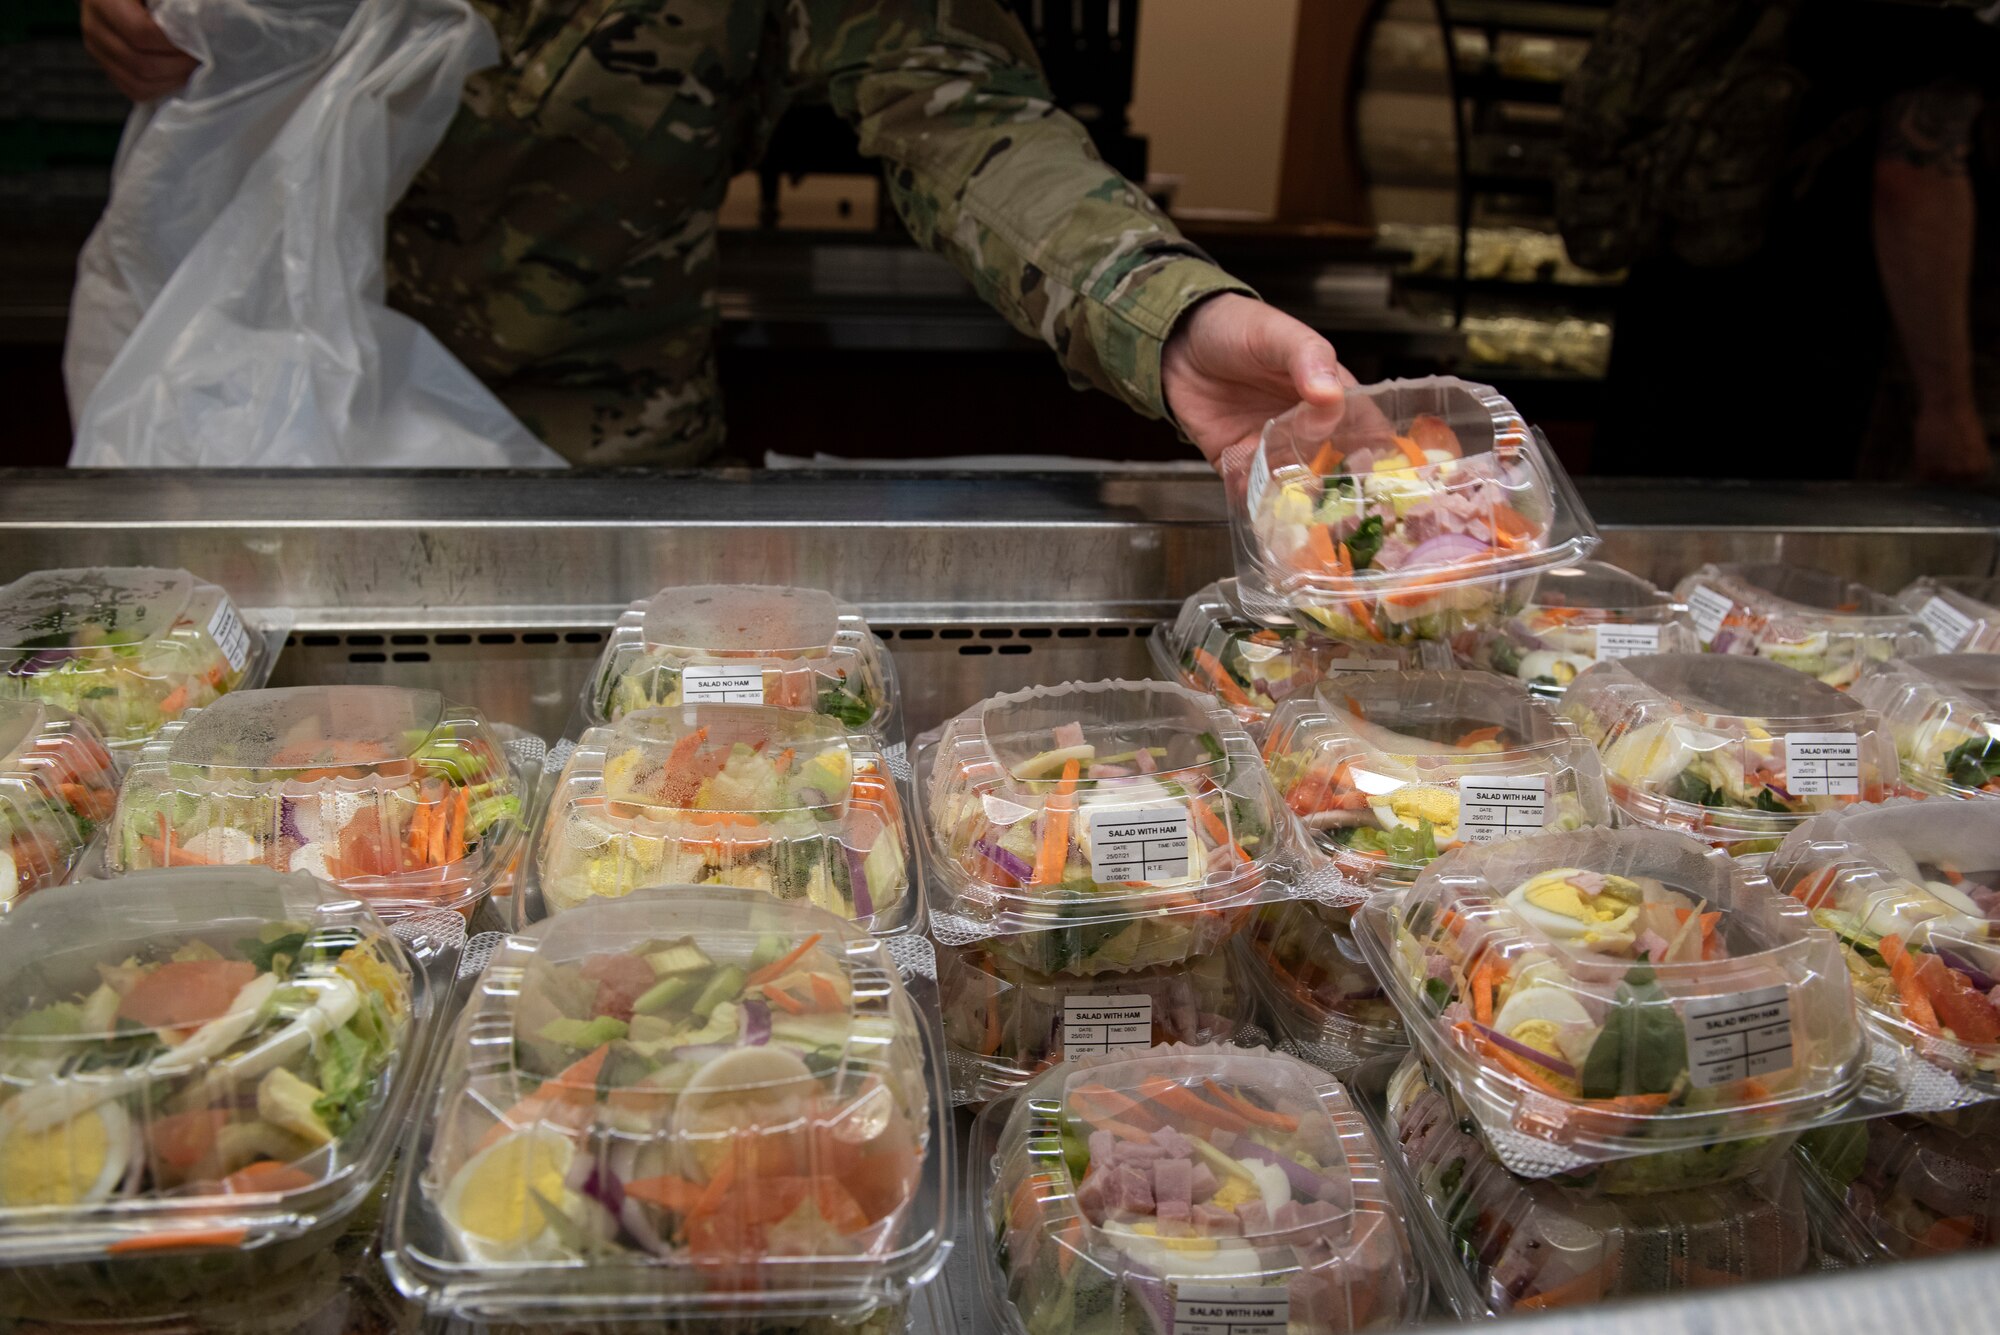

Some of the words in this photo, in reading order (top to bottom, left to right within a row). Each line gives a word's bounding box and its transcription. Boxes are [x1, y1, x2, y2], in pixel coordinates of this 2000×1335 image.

[1706, 1017, 1736, 1030] SALAD
[1738, 1012, 1760, 1023] WITH
[1761, 1008, 1779, 1019] HAM
[1189, 1307, 1223, 1317] SALAD
